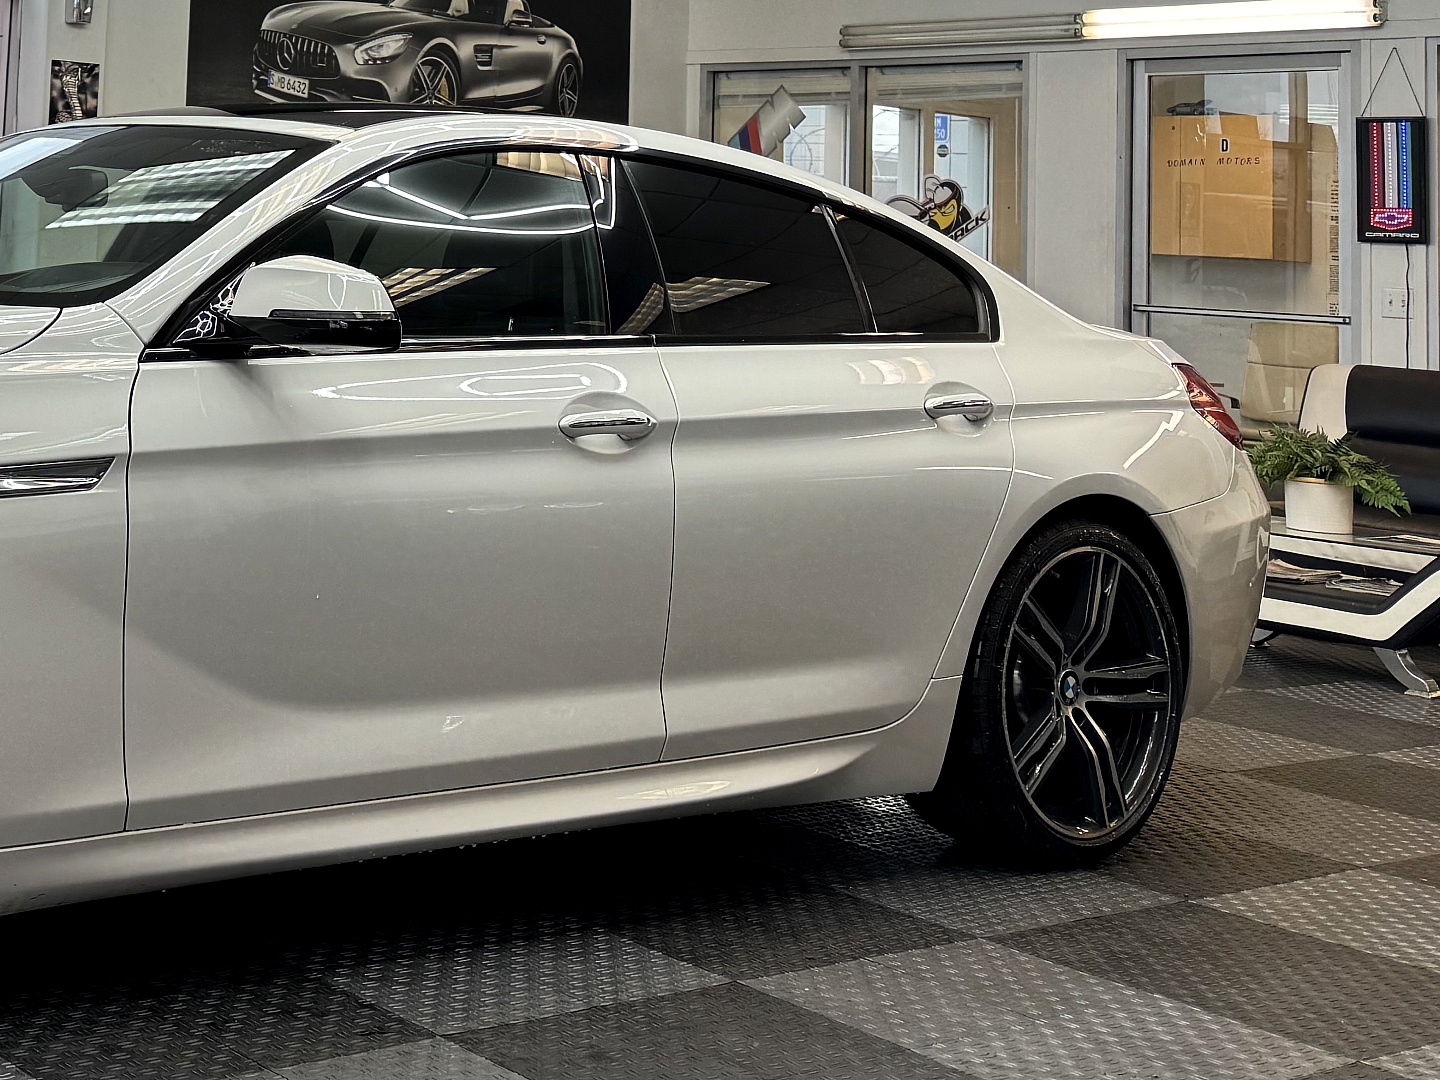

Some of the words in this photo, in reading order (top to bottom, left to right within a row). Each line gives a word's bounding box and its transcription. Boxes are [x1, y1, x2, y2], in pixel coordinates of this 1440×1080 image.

[286, 79, 307, 95] 6432
[1167, 158, 1206, 167] DOMAIN
[1217, 156, 1260, 166] MOTORS
